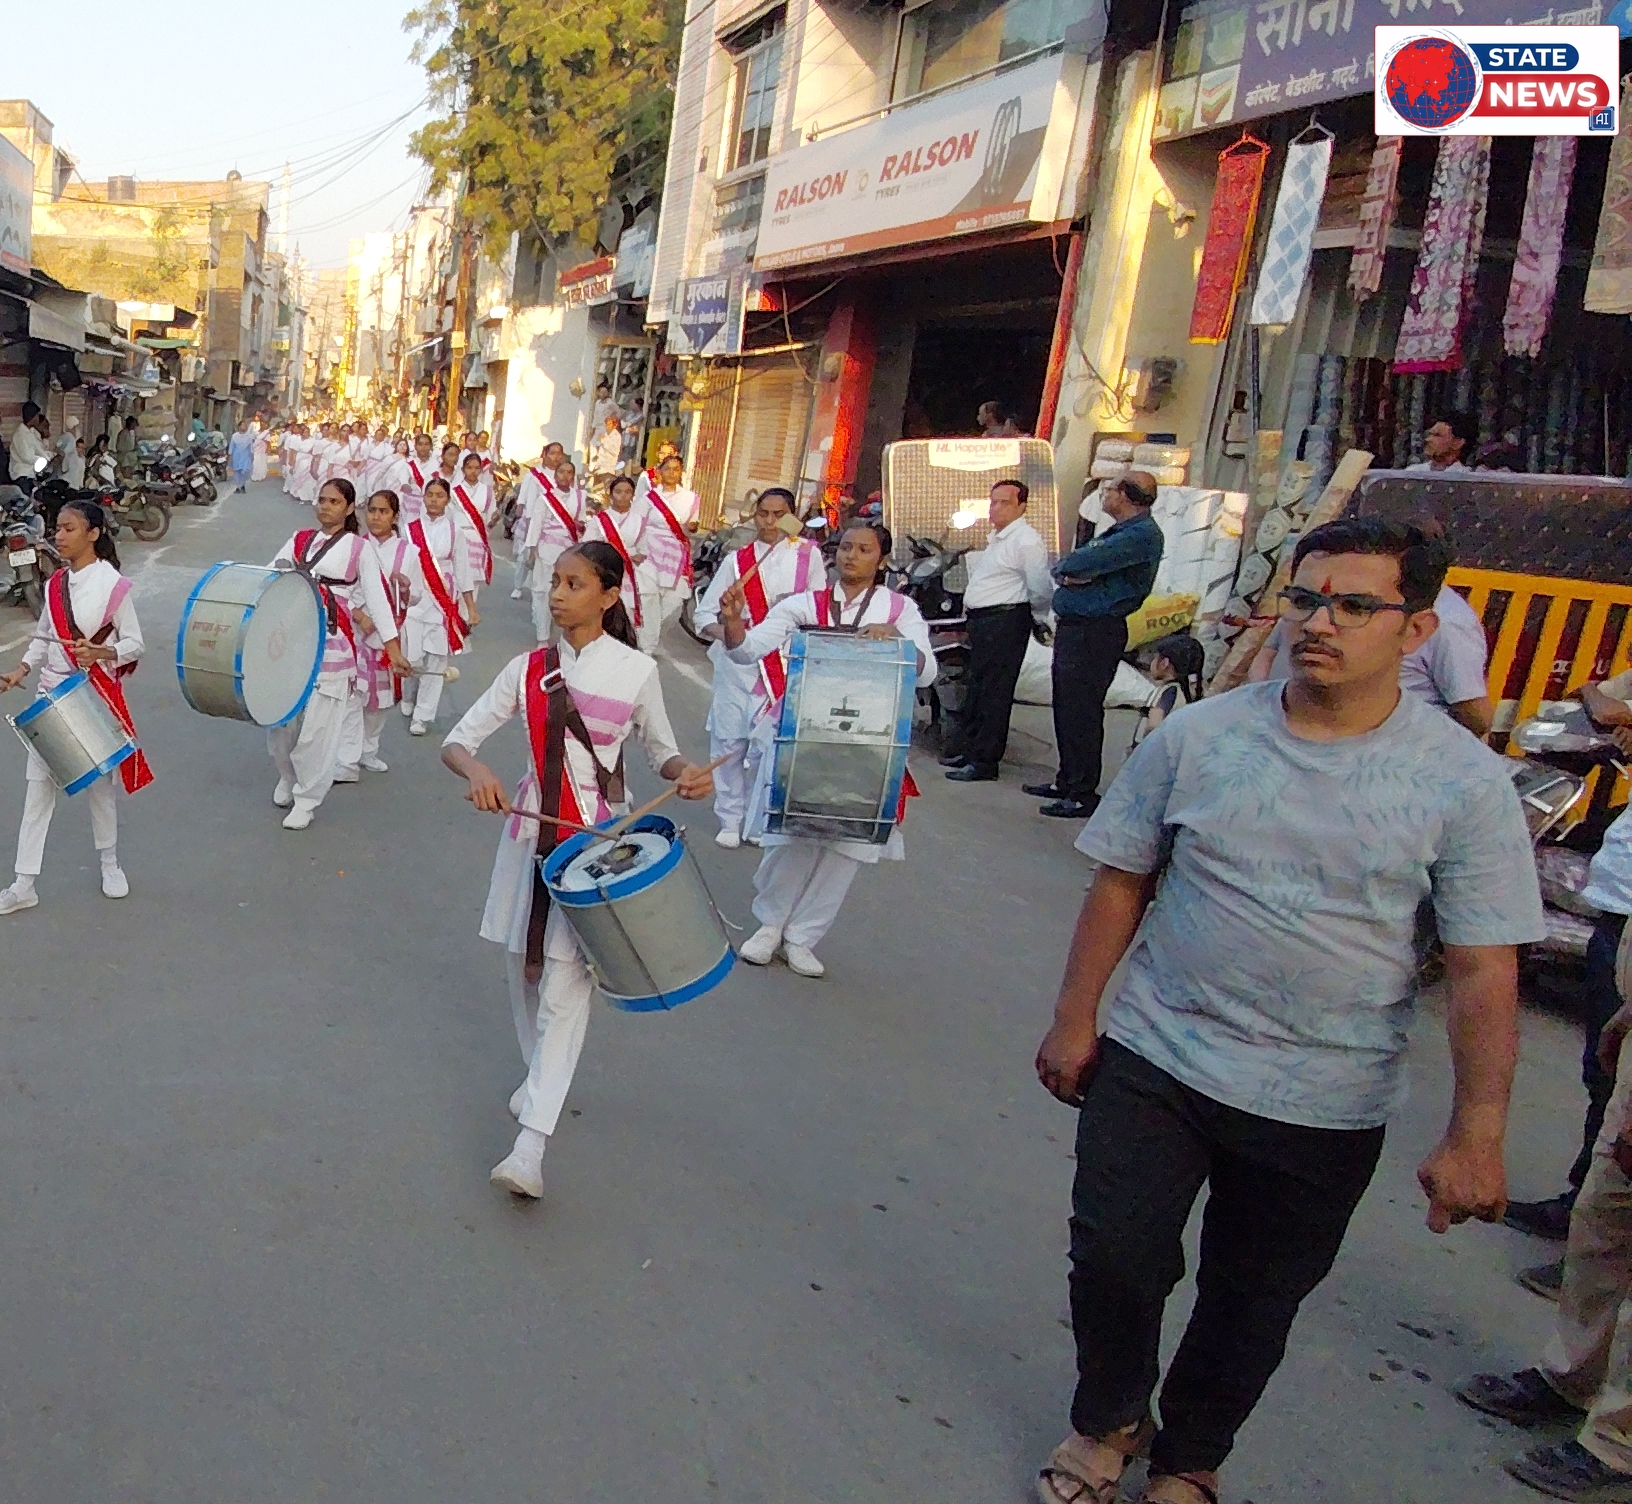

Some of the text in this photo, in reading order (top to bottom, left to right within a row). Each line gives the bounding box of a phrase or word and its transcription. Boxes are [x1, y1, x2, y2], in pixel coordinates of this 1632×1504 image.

[774, 129, 980, 213] RALSON RALSON
[955, 442, 988, 454] Happy
